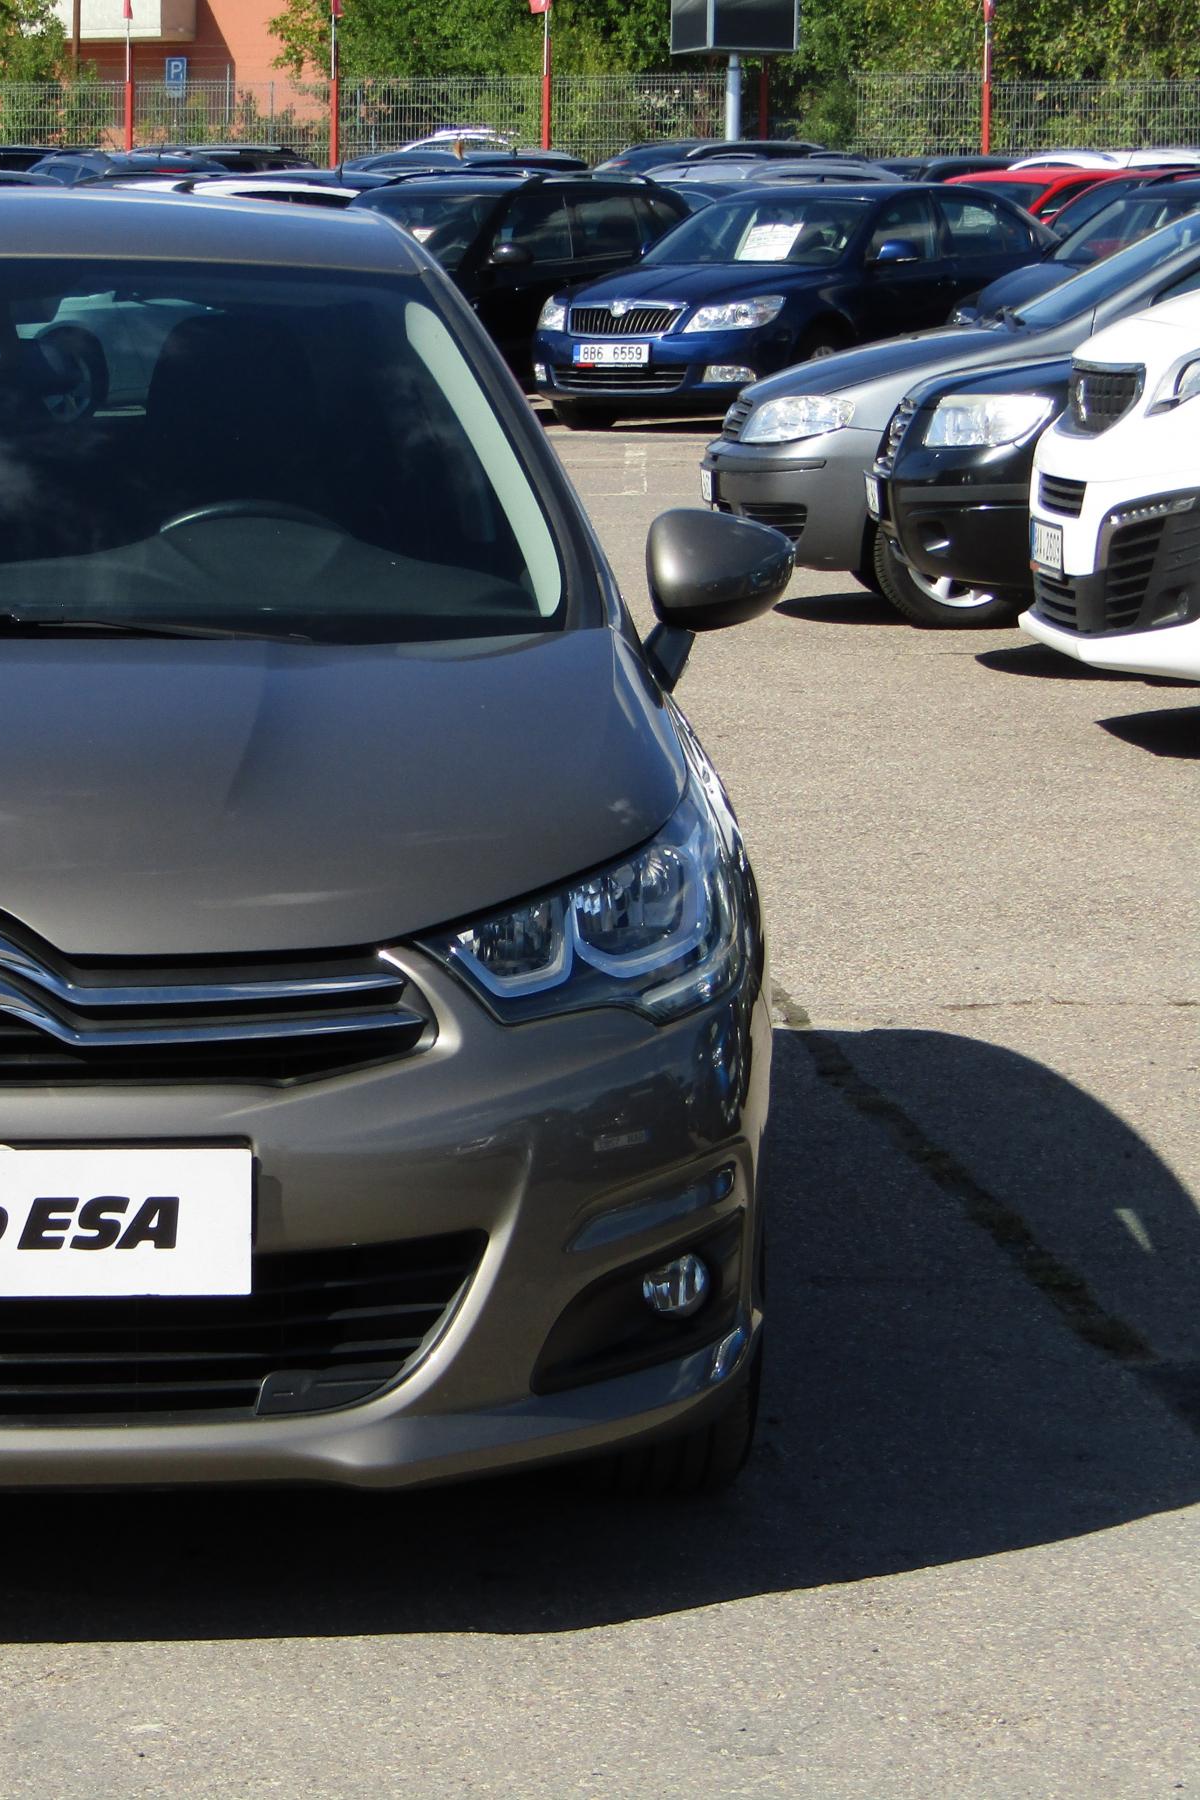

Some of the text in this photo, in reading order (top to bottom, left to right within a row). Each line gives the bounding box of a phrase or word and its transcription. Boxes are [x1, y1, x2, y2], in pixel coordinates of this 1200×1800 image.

[171, 61, 182, 79] P
[613, 346, 642, 361] 6559
[17, 1195, 180, 1250] ESA
